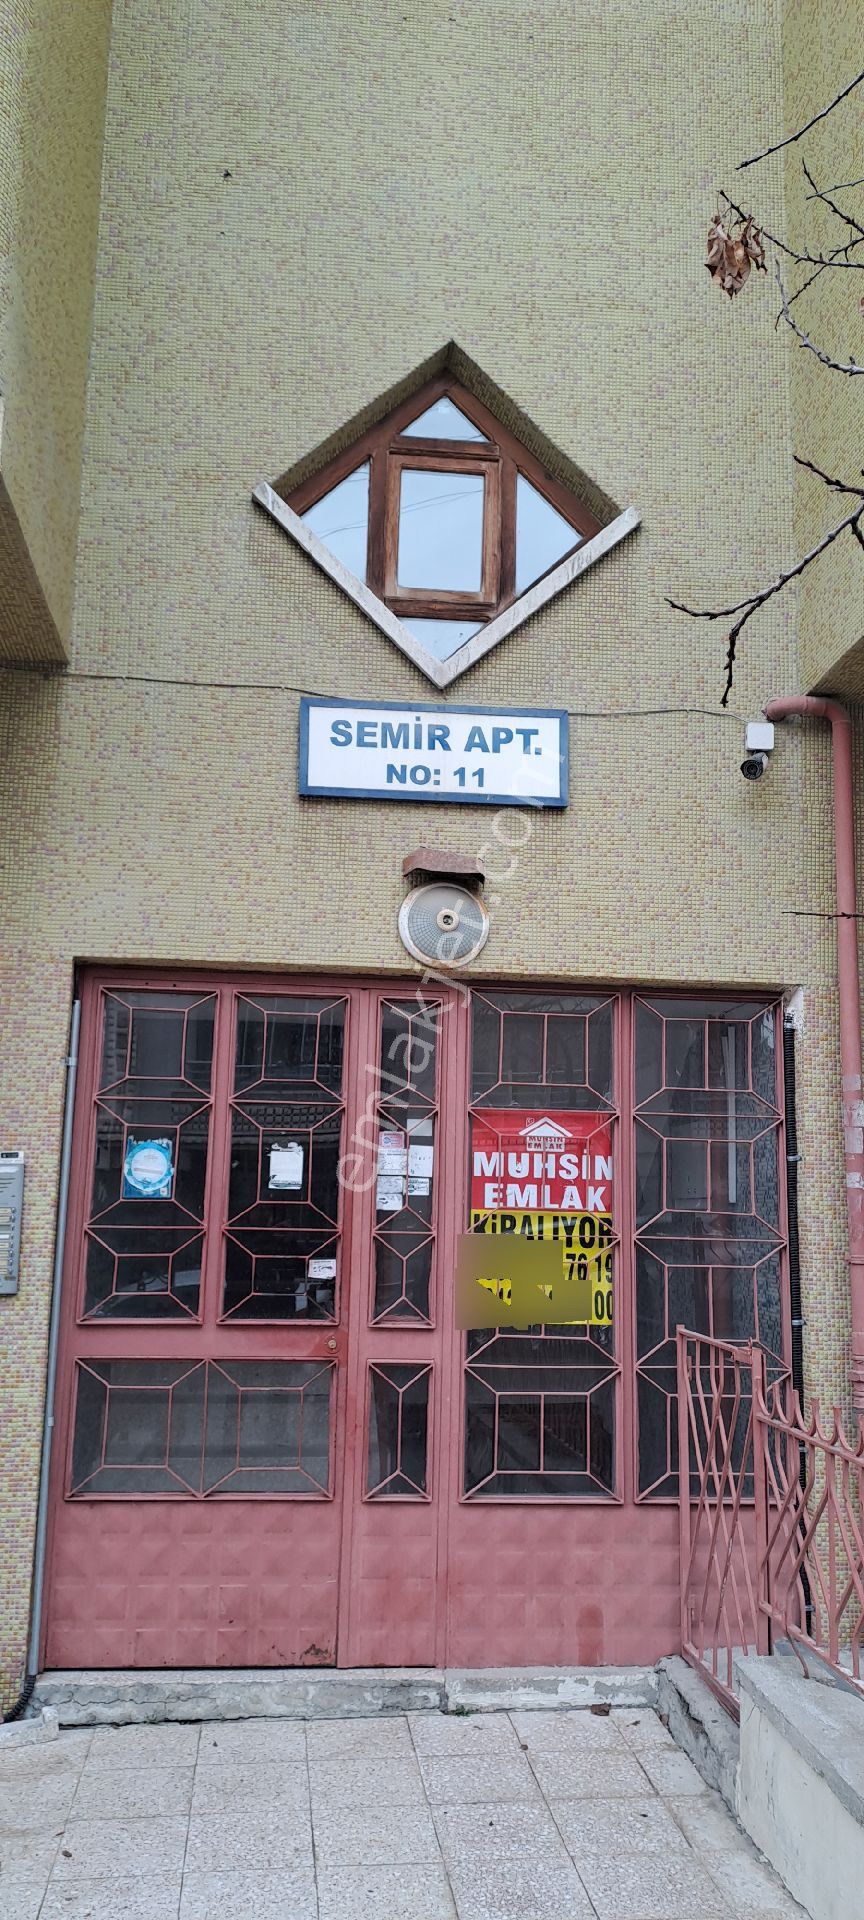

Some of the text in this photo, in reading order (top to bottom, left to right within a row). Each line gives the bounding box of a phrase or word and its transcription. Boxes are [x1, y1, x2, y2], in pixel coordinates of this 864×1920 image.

[329, 716, 542, 755] SEMİR APT.
[386, 763, 485, 788] NO: 11
[484, 1183, 606, 1212] EMLAK
